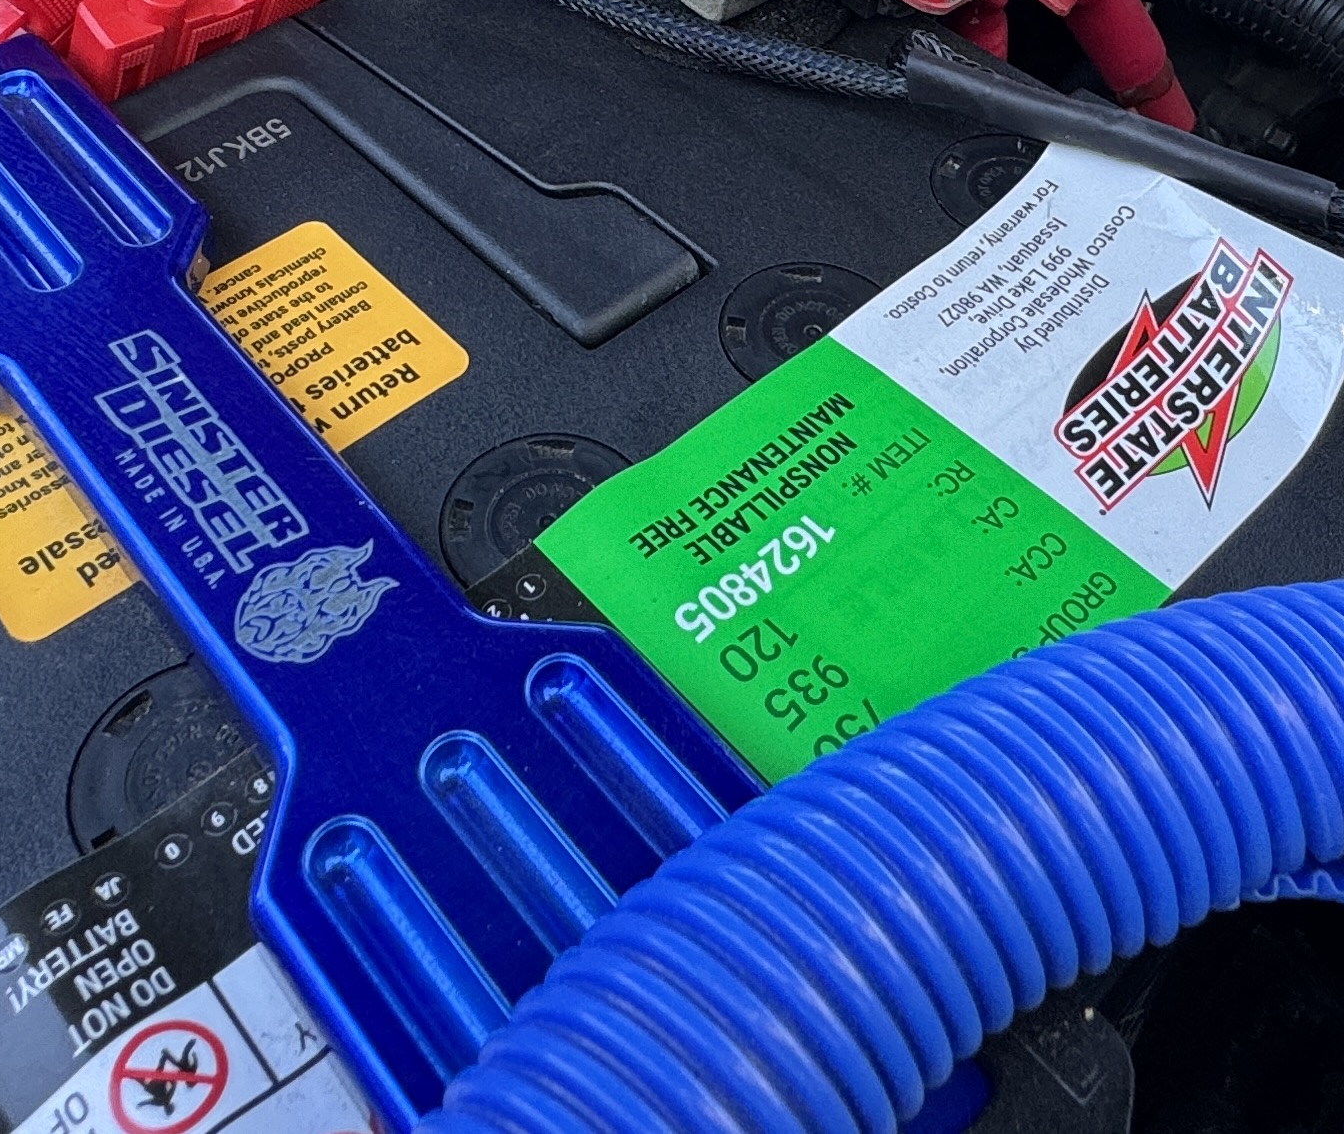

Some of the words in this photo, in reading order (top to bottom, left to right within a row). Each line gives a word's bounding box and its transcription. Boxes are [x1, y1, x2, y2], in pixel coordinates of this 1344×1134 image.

[174, 118, 292, 182] 5BKJ12
[1030, 178, 1060, 203] For
[978, 199, 1038, 248] warranty,
[997, 216, 1068, 272] Issaquah,
[1085, 204, 1136, 257] Costco
[206, 263, 262, 296] cancer.
[255, 246, 327, 290] chemicals
[931, 272, 954, 289] to
[947, 245, 986, 279] return
[1047, 245, 1072, 272] 999
[235, 264, 328, 319] reproductive
[290, 291, 317, 308] the
[313, 280, 368, 314] contain
[314, 281, 334, 294] to
[882, 285, 938, 320] Costco.
[975, 271, 1007, 298] WA
[1008, 270, 1049, 303] Lake
[1029, 256, 1096, 317] Wholesale
[249, 304, 289, 331] state
[280, 309, 314, 335] lead
[317, 299, 372, 334] Battery
[936, 292, 984, 329] 98027
[968, 294, 1016, 327] Drive,
[1038, 273, 1111, 343] Distributed
[250, 329, 281, 354] and
[267, 326, 317, 358] posts,
[305, 328, 422, 400] batteries
[938, 314, 1029, 378] Corporation,
[1016, 330, 1044, 354] by
[1062, 249, 1246, 453] BATTERIES
[329, 362, 422, 420] Return
[1084, 260, 1288, 500] INTERSTATE
[108, 329, 310, 548] SINISTER
[687, 392, 856, 521] MAINTENANCE
[865, 426, 932, 480] ITEM
[94, 380, 260, 575] DIESEL
[114, 447, 166, 504] MADE
[158, 505, 188, 533] IN
[682, 430, 859, 566] NONSPILLABLE
[840, 471, 874, 498] #:
[926, 459, 976, 498] RC:
[627, 508, 699, 560] FREE
[970, 495, 1020, 535] CA:
[673, 514, 837, 644] 1624805
[1003, 532, 1068, 587] CCA:
[718, 617, 799, 683] 120
[763, 654, 850, 733] 935
[93, 875, 122, 901] JA
[43, 903, 75, 932] FE
[5, 908, 141, 1015] BATTERY!
[72, 938, 157, 1002] OPEN
[129, 965, 177, 1008] DO
[66, 992, 133, 1059] NOT
